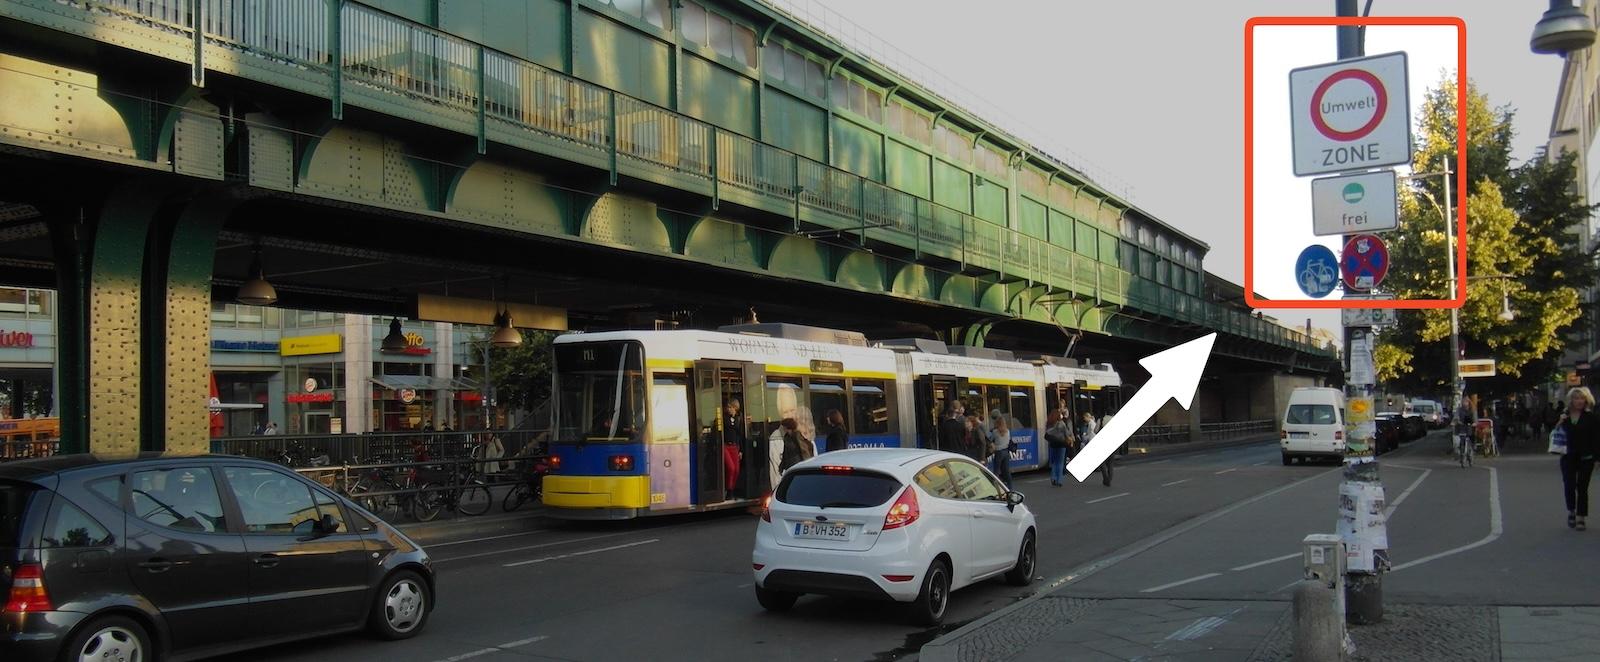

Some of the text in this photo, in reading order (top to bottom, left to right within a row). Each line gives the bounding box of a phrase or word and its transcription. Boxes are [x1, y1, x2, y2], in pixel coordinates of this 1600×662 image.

[1321, 97, 1376, 115] Umwelt
[1322, 143, 1380, 167] ZONE
[1342, 212, 1368, 226] frei
[802, 525, 847, 537] B VH 352
